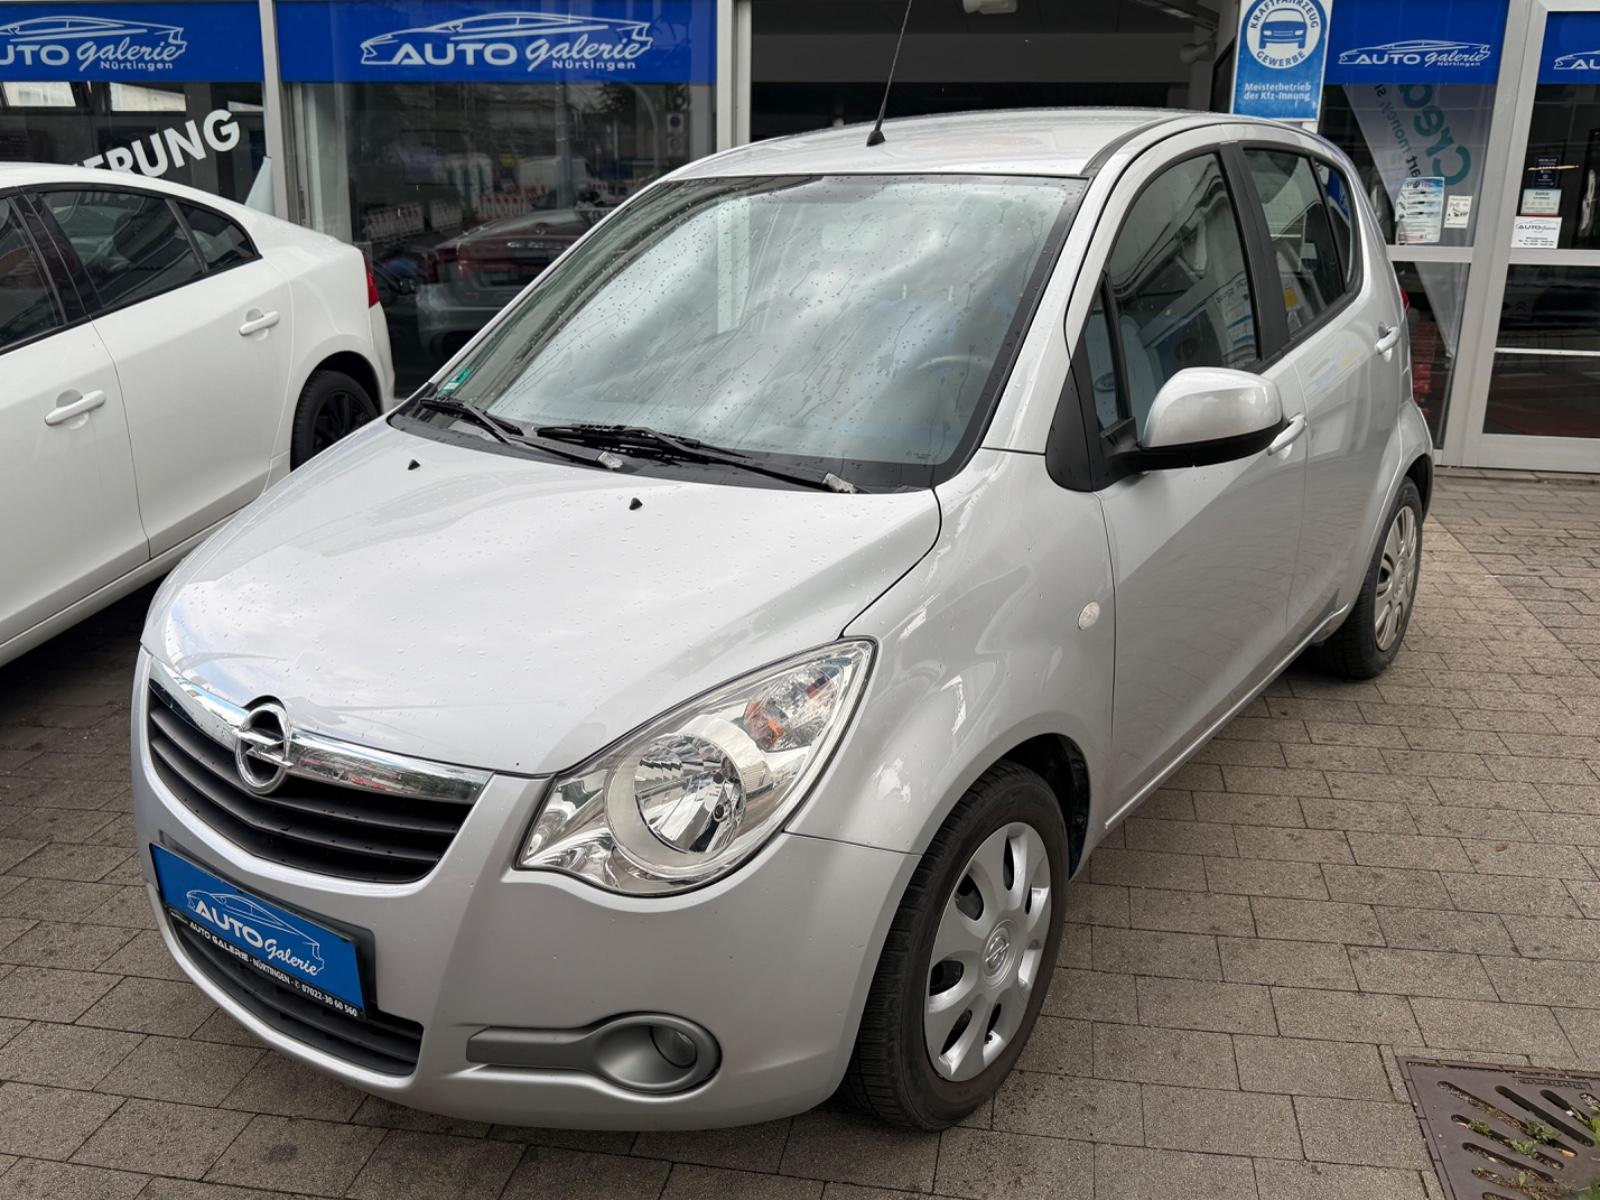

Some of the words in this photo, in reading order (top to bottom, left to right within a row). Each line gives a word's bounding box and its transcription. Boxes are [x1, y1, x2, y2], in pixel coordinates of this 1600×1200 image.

[393, 43, 518, 66] AUTO
[1256, 50, 1305, 67] GEWERBE
[1354, 53, 1421, 65] AUTO
[100, 60, 173, 71] Nürtingen
[552, 60, 635, 71] Nürtingen
[1244, 82, 1312, 92] Meisterbetrieb
[1243, 91, 1260, 101] der
[1260, 91, 1311, 103] Kfz-Innung
[189, 922, 211, 940] AUTO
[211, 935, 249, 962] GALERIE
[195, 900, 264, 949] AUTO
[264, 938, 319, 977] Galerie
